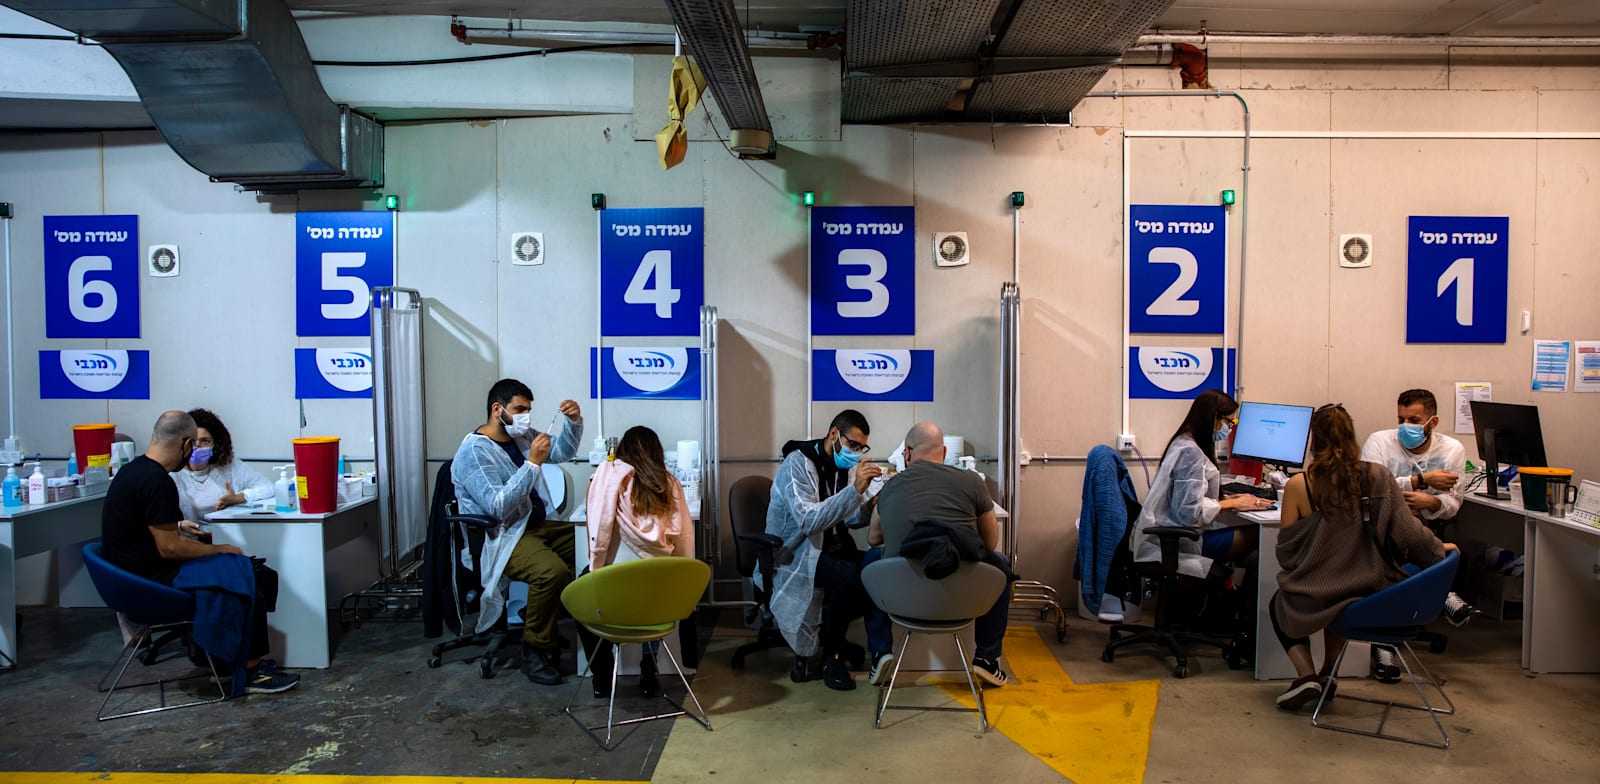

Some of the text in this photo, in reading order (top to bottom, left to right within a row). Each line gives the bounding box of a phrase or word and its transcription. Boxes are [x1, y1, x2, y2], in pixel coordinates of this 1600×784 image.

[306, 226, 383, 239] עמדה מס'
[611, 223, 692, 237] עמדה מס'
[822, 222, 904, 236] עמדה מס'
[1135, 220, 1215, 234] עמדה מס'
[54, 230, 128, 243] עמדה מס'
[1419, 231, 1498, 244] עמדה מס'
[321, 252, 370, 319] 5
[623, 250, 681, 318] 4
[836, 248, 890, 318] 3
[1145, 246, 1200, 316] 2
[68, 255, 118, 323] 6
[1437, 257, 1475, 326] 1
[75, 359, 108, 369] מכבי
[330, 358, 365, 368] מכבי
[628, 358, 665, 368] מכבי
[851, 359, 888, 370] מכבי
[1154, 357, 1190, 368] מכבי
